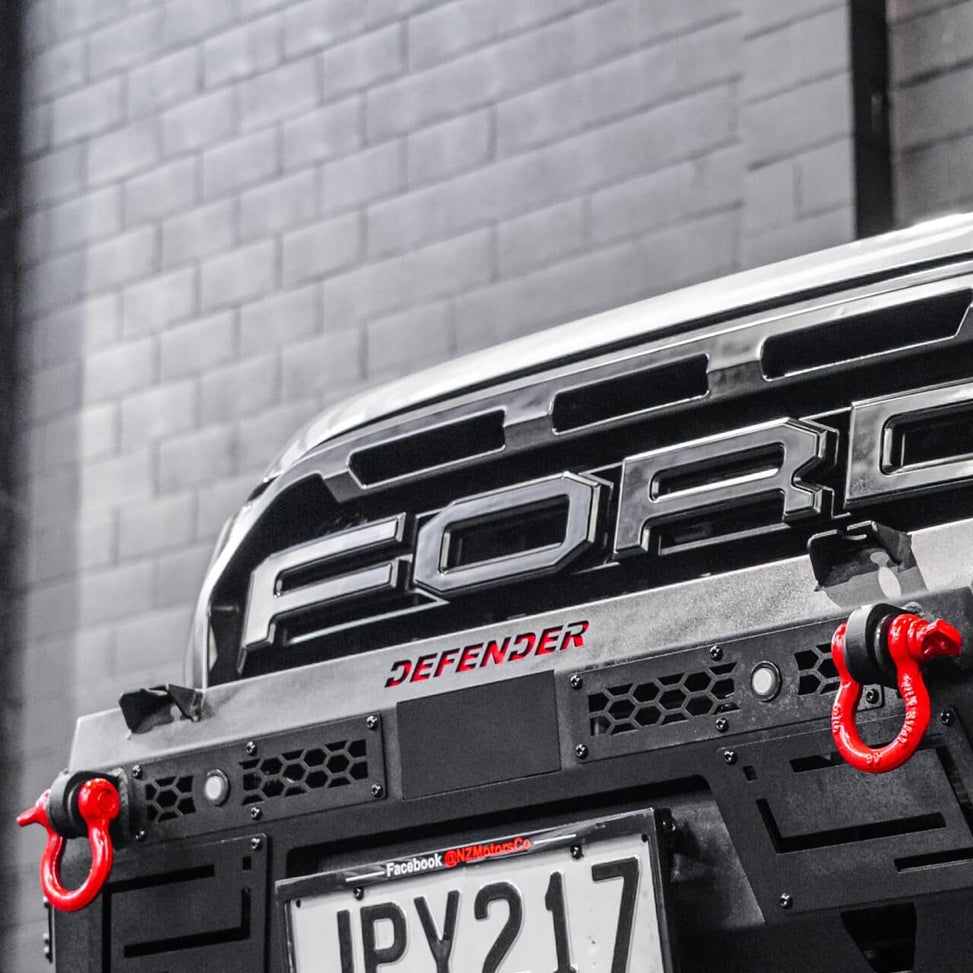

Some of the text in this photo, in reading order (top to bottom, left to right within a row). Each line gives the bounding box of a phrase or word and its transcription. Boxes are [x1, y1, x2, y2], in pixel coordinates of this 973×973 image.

[384, 620, 589, 688] DEFENDER
[386, 836, 531, 877] Facebook @NZMotorsCo
